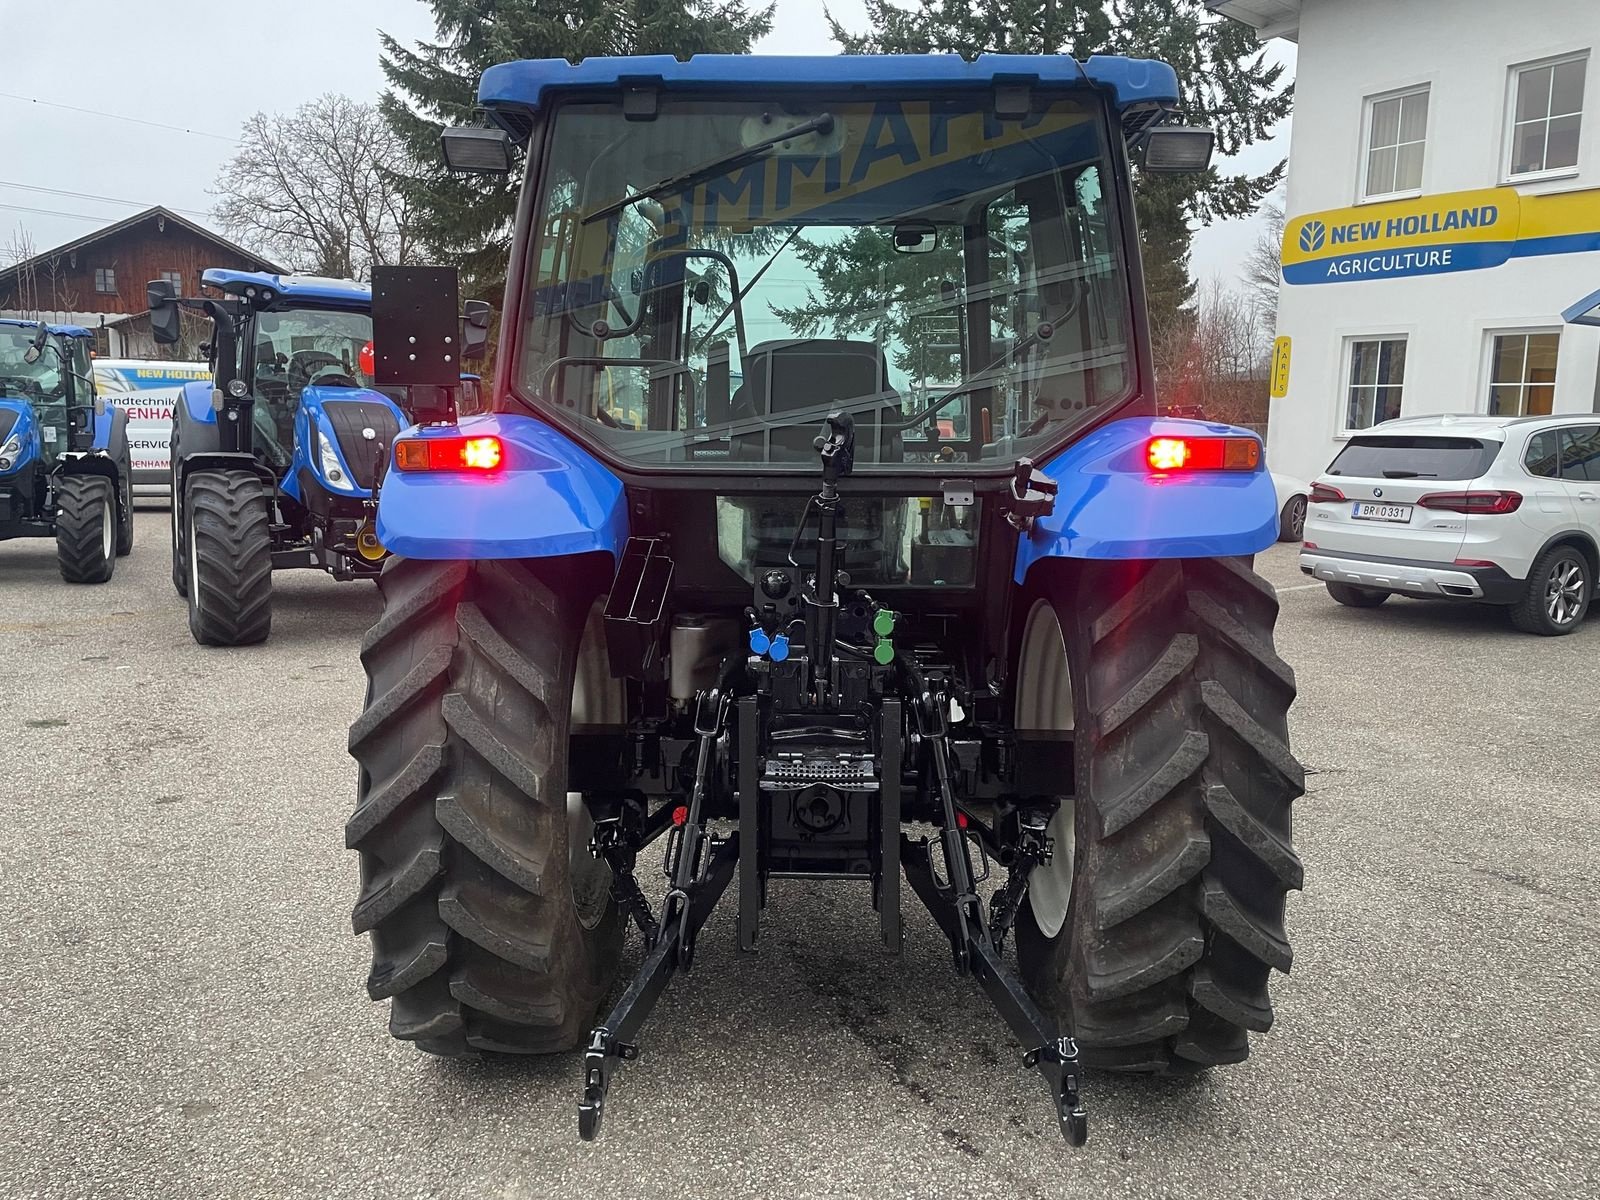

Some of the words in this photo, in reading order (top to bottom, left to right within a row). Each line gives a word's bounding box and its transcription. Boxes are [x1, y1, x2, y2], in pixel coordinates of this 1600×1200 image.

[1330, 220, 1382, 245] NEW
[1385, 205, 1499, 238] HOLLAND
[1326, 249, 1453, 277] AGRICULTURE
[1279, 341, 1289, 392] PARTS
[136, 368, 164, 379] NEW
[98, 396, 175, 406] andtechnik
[126, 407, 174, 420] ENHA
[128, 440, 172, 449] SERVIC
[129, 460, 172, 468] DENHAM
[1363, 505, 1376, 516] BR
